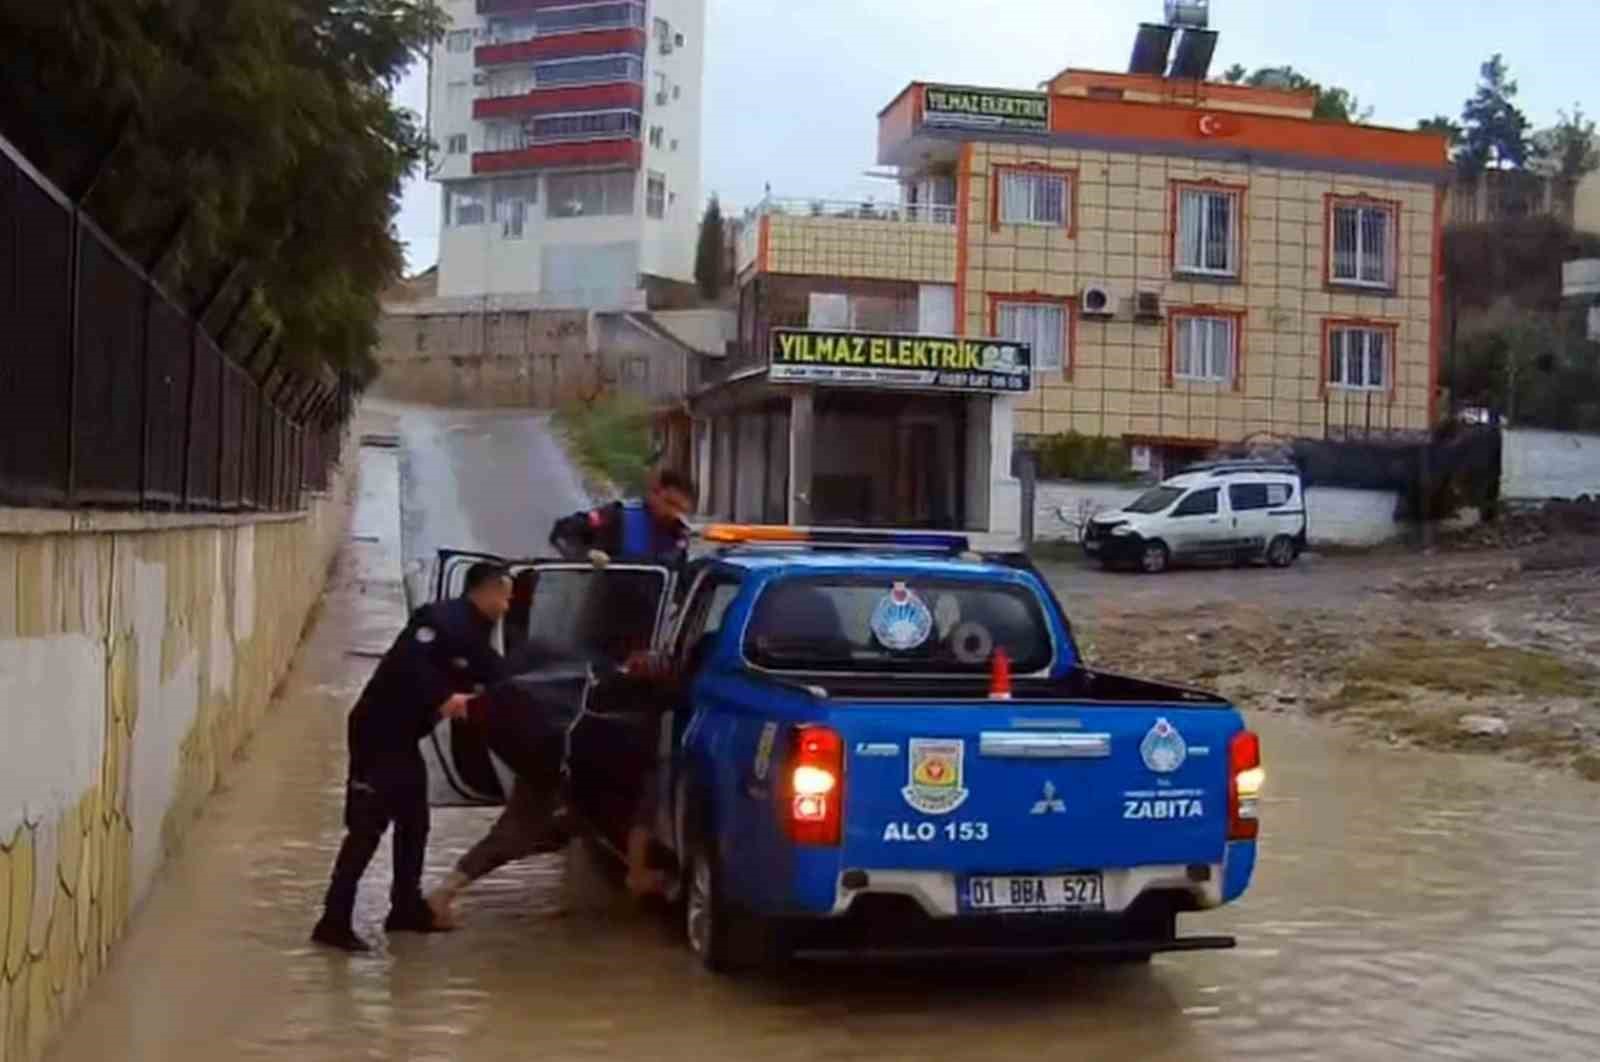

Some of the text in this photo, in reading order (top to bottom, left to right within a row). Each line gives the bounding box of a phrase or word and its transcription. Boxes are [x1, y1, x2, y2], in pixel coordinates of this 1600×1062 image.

[928, 91, 979, 112] YILMAZ
[780, 333, 981, 368] YILMAZ ELEKTRİK
[1123, 799, 1203, 819] ZABITA
[883, 822, 989, 841] ALO 153
[973, 878, 1098, 904] 01 BBA 527
